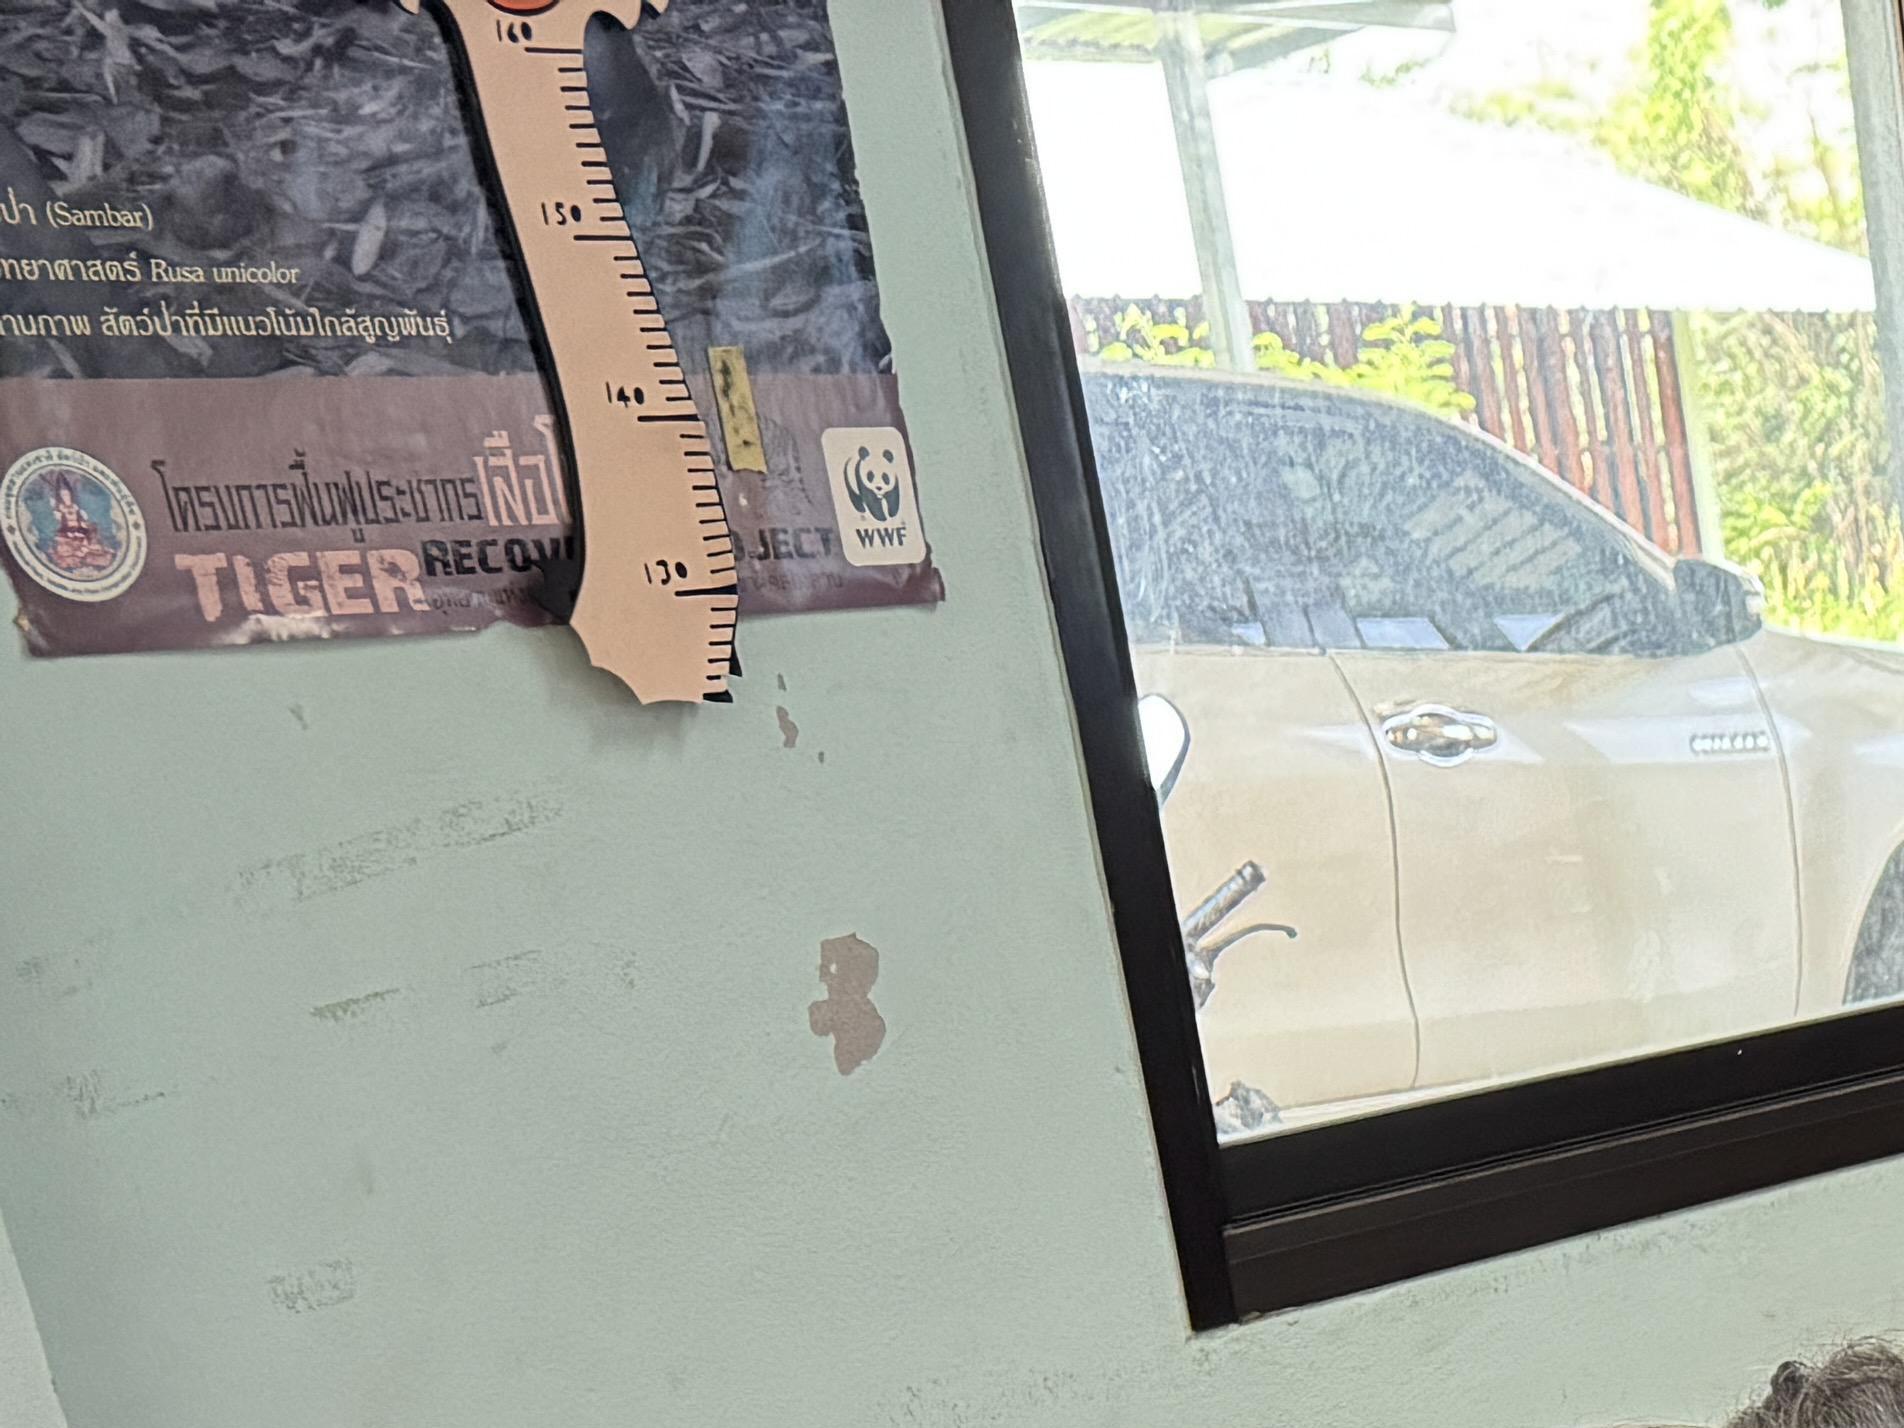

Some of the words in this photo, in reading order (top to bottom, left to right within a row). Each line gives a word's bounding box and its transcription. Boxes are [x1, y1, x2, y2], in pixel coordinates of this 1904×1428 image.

[497, 19, 533, 43] 160
[0, 187, 37, 225] ป่า
[45, 200, 154, 231] (Sambar)
[541, 201, 582, 226] 150
[0, 251, 142, 282] ทยาศาสตร์
[151, 260, 205, 283] Rusa
[212, 262, 300, 285] unicolor
[605, 381, 645, 408] 140
[856, 526, 908, 550] WWF
[421, 537, 577, 577] RECOV
[733, 527, 834, 561] JECT
[644, 559, 688, 585] 130
[174, 549, 432, 623] TIGER
